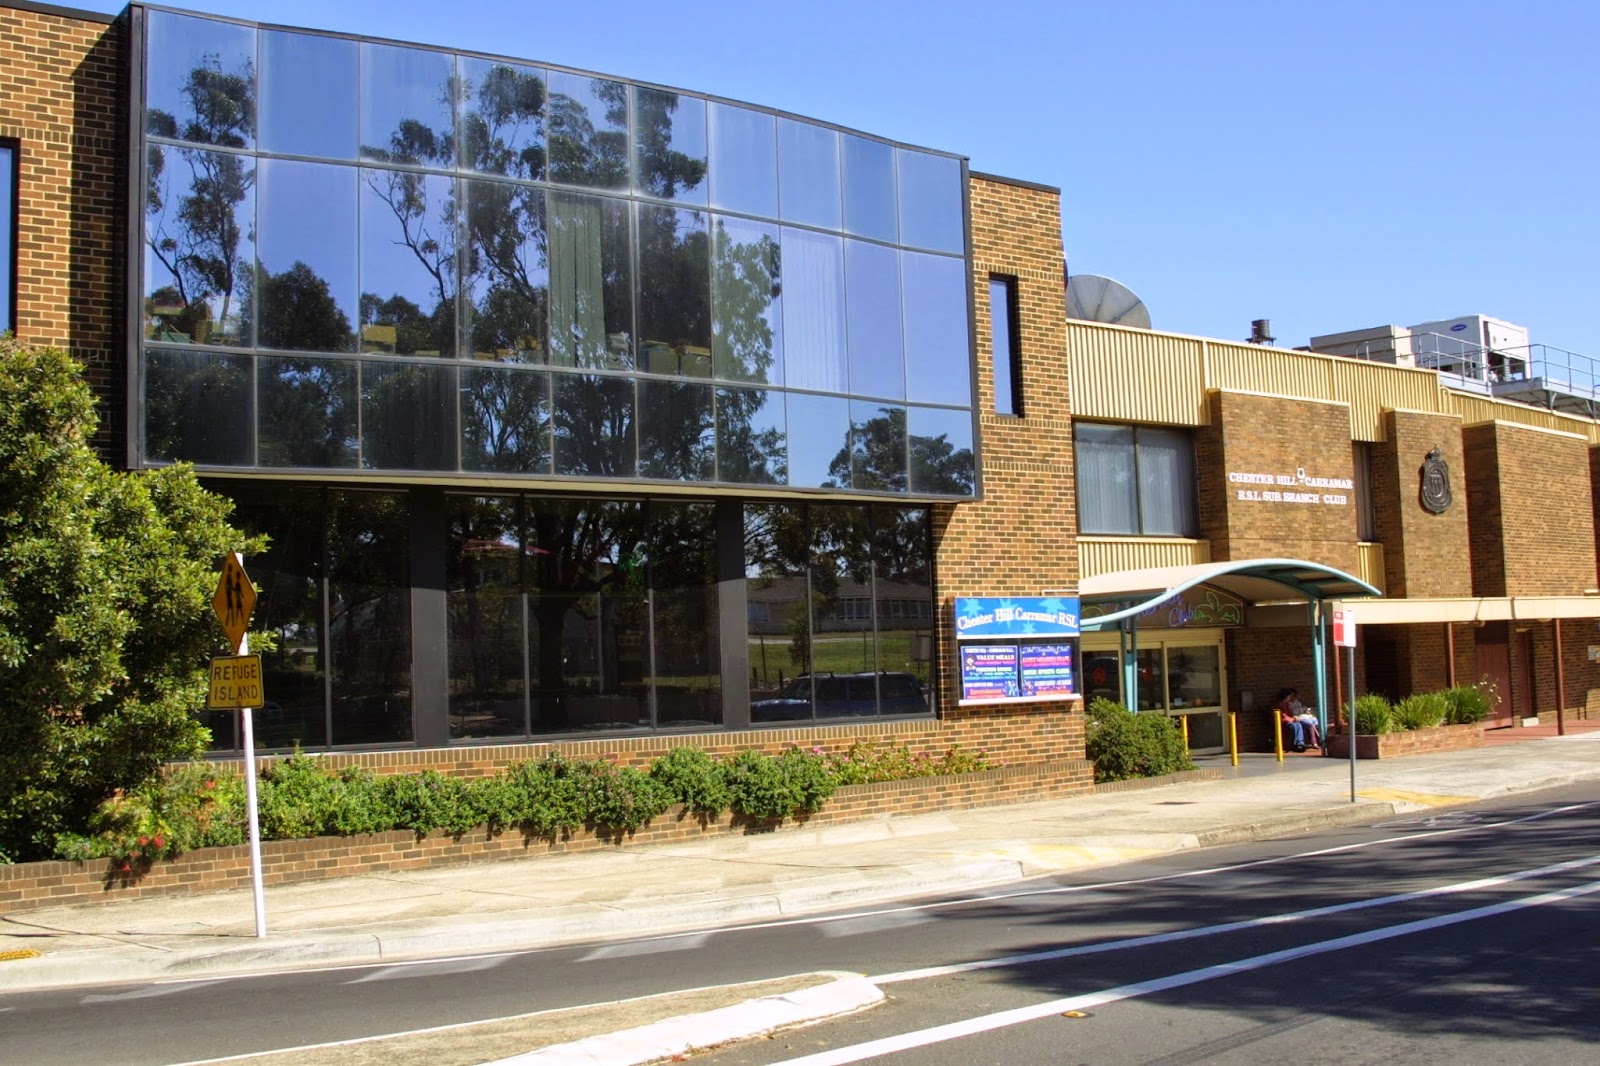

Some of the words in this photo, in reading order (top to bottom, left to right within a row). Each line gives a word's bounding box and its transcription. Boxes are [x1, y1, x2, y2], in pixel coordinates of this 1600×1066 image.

[1229, 472, 1274, 484] CHESTER
[1277, 475, 1298, 485] HILL
[1305, 477, 1353, 489] CARRAMAR
[1283, 492, 1319, 504] BRANCH
[1323, 494, 1347, 505] CLUB
[957, 613, 994, 630] Chester
[994, 607, 1014, 622] Hill
[1015, 607, 1057, 623] Carramar
[1058, 612, 1079, 629] RSL
[1169, 605, 1194, 627] Club
[214, 664, 257, 680] REFUGE
[214, 685, 258, 700] ISLAND
